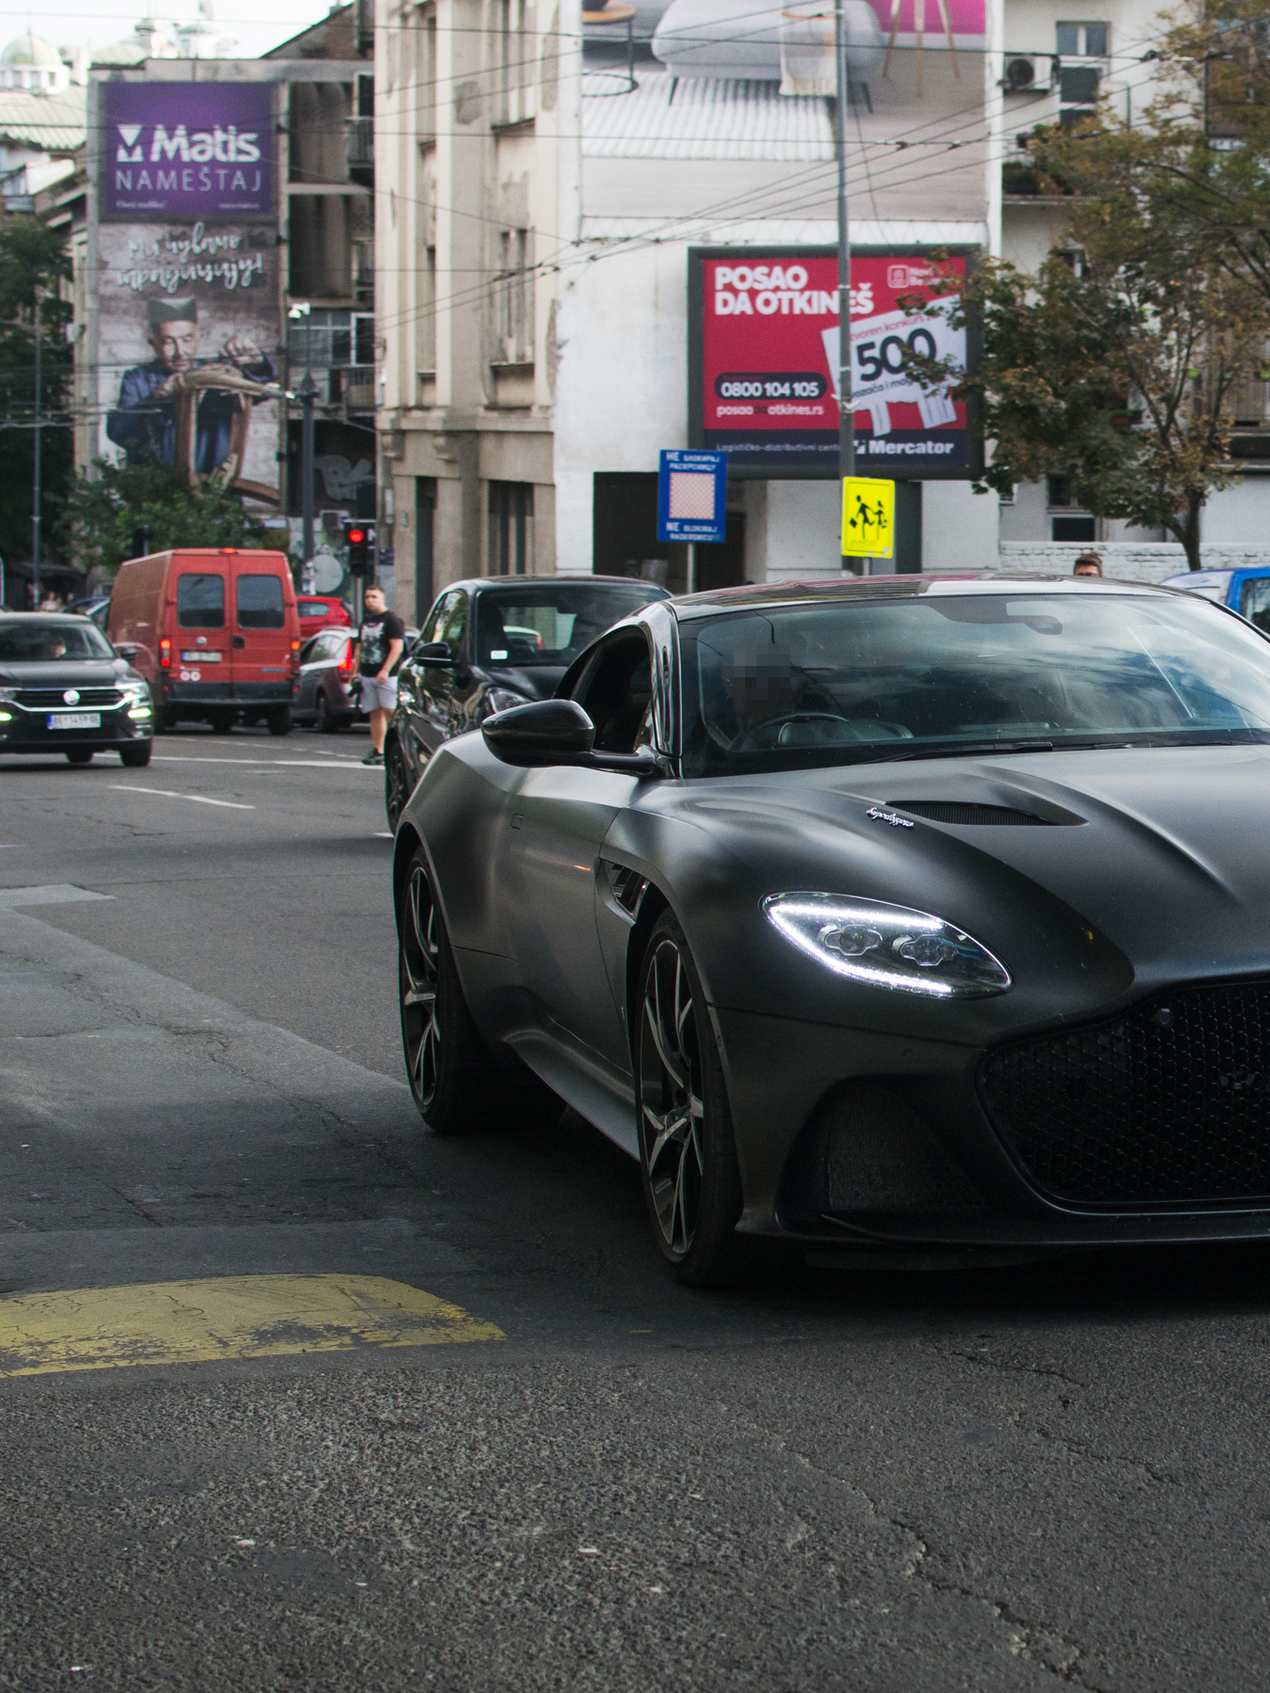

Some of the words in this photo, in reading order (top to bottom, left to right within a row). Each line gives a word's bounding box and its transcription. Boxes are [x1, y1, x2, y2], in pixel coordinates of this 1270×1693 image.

[151, 124, 261, 162] Matis
[115, 166, 261, 191] NAMEŠTAJ
[715, 265, 808, 290] POSAO
[715, 291, 753, 315] DA
[856, 328, 937, 382] 500
[721, 382, 763, 397] 0800
[764, 382, 791, 397] 104
[793, 382, 819, 397] 105
[868, 440, 955, 454] Mercator
